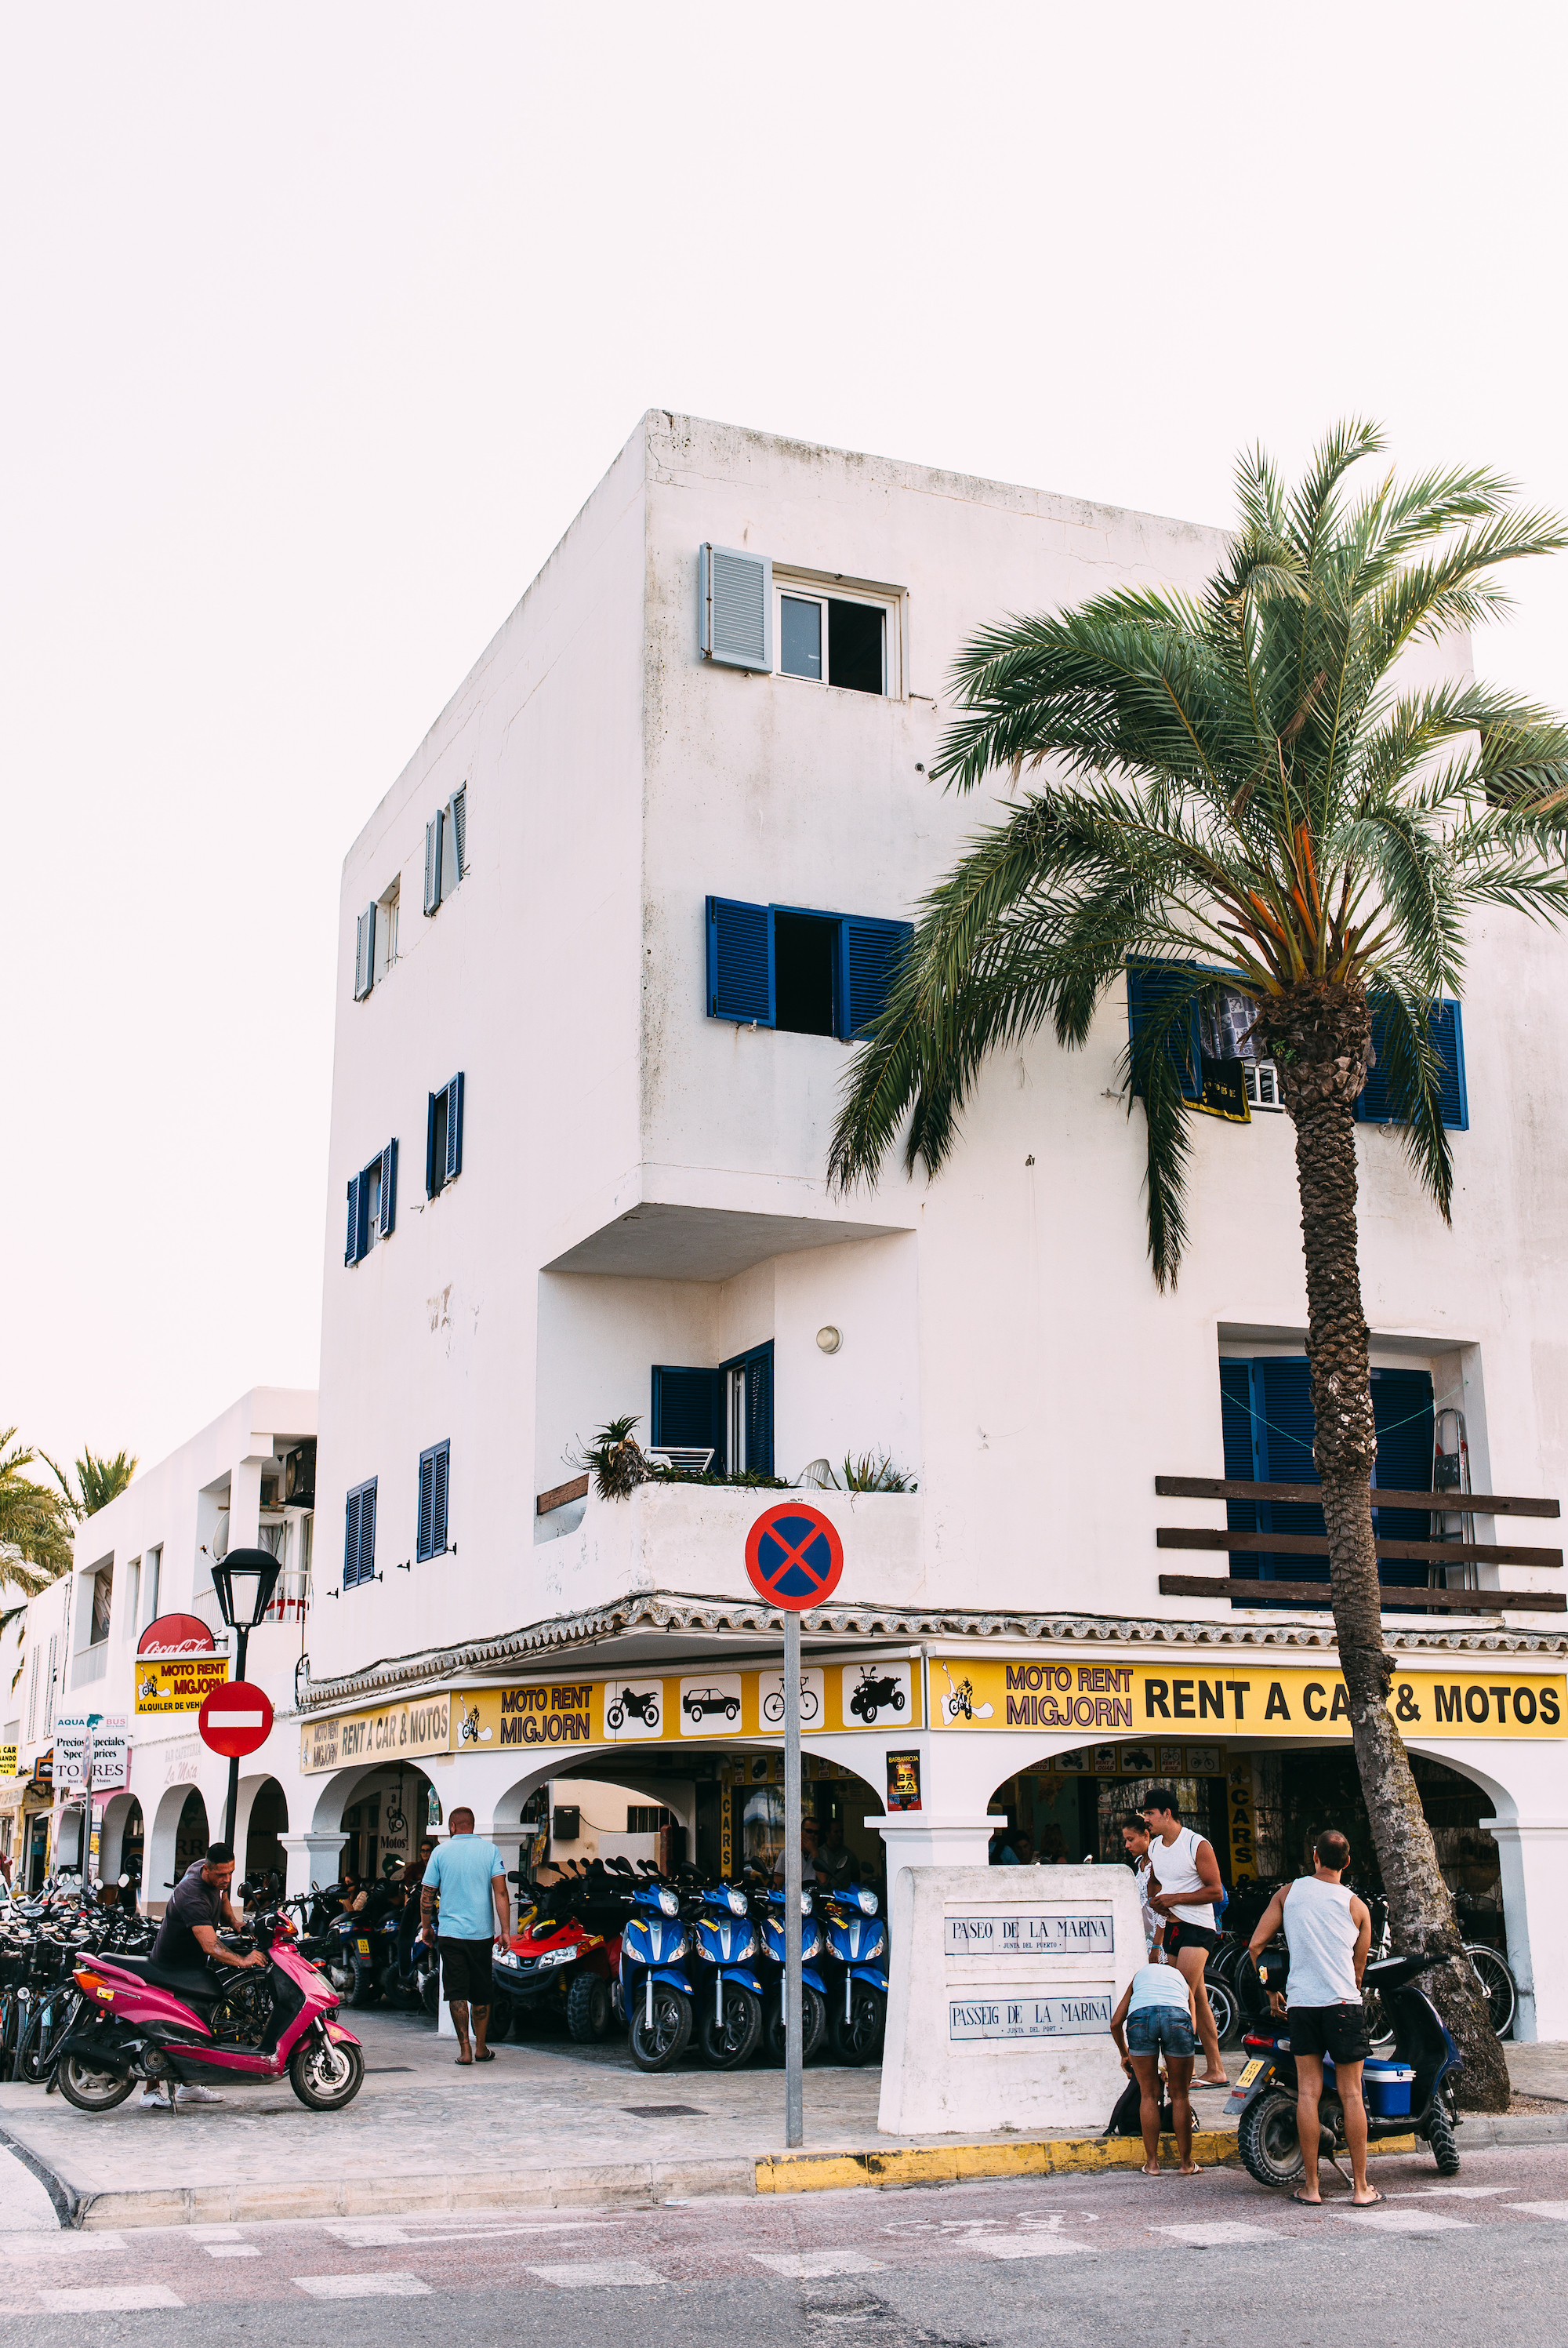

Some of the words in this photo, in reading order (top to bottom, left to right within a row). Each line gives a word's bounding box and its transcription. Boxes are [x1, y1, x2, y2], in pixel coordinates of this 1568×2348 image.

[161, 1664, 194, 1677] MOTO
[197, 1663, 226, 1675] RENT
[1006, 1665, 1072, 1691] MOTO
[1078, 1667, 1134, 1692] RENT
[138, 1703, 173, 1711] ALQUILER
[500, 1688, 548, 1714] MOTO
[551, 1685, 593, 1710] RENT
[1006, 1696, 1133, 1727] MIGJORN
[1145, 1678, 1250, 1720] RENT
[1264, 1681, 1291, 1721] A
[1302, 1682, 1352, 1721] CA
[1396, 1684, 1421, 1721] &
[1433, 1685, 1560, 1725] MOTOS
[314, 1722, 327, 1743] MOTO
[327, 1720, 339, 1739] RENT
[342, 1721, 365, 1756] RENT
[366, 1720, 372, 1751] A
[376, 1715, 397, 1750] CAR
[399, 1713, 407, 1746] &
[410, 1703, 448, 1744] MOTOS
[499, 1712, 590, 1744] MIGJORN
[56, 1737, 84, 1746] Precios
[93, 1736, 125, 1748] speciales
[63, 1749, 83, 1760] Spec
[93, 1748, 117, 1760] prices
[313, 1742, 339, 1768] MIGJORN
[56, 1764, 124, 1777] TORES
[722, 1798, 731, 1866] CARS
[1230, 1789, 1253, 1864] CARS
[380, 1835, 406, 1849] Motos
[953, 1921, 993, 1939] PASEO
[1002, 1921, 1019, 1938] DE
[1029, 1921, 1050, 1938] LA
[1057, 1921, 1108, 1938] MARINA
[953, 2006, 1000, 2026] PASSEIG
[1007, 2005, 1022, 2024] DE
[1035, 2004, 1051, 2023] LA
[1061, 2002, 1108, 2022] MARINA
